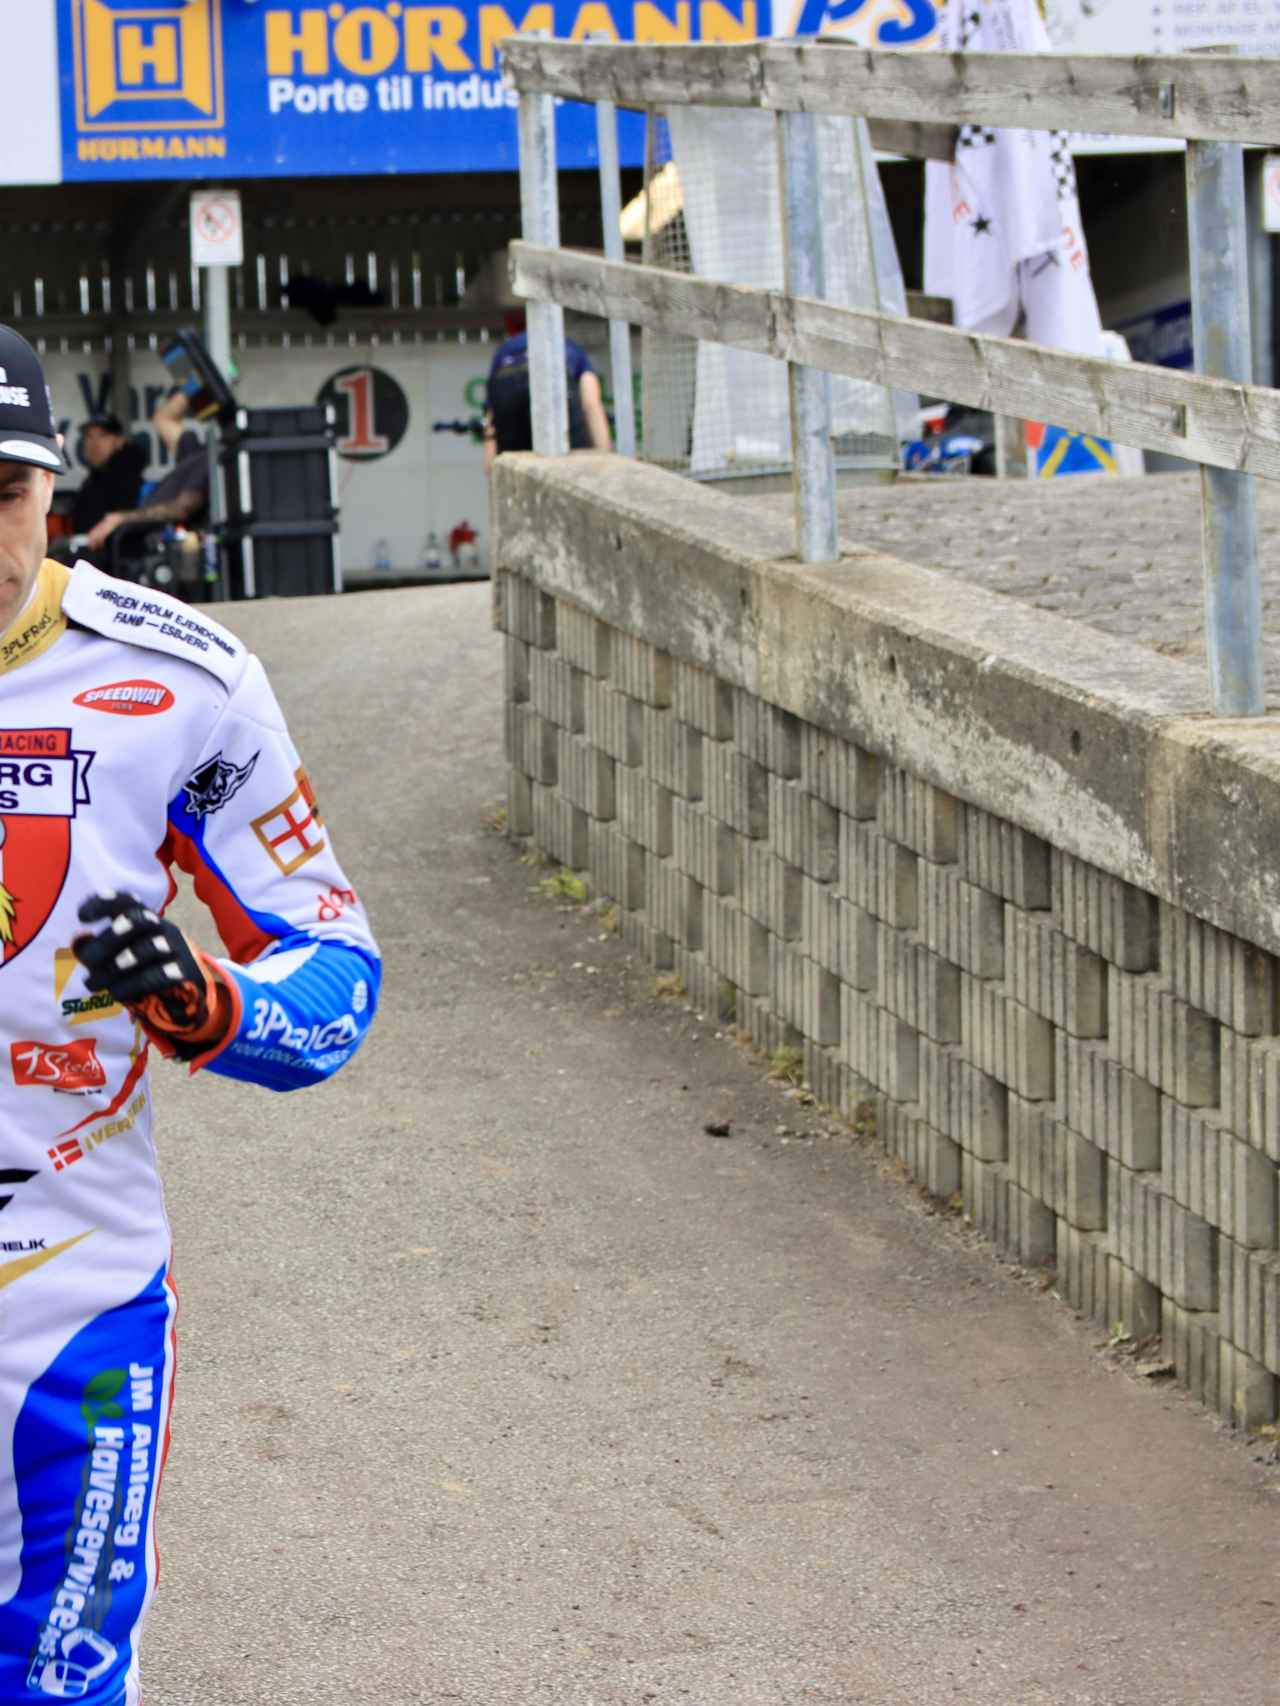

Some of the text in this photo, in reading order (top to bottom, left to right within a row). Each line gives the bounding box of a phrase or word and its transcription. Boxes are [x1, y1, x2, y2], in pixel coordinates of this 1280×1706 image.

[270, 78, 369, 113] Porte
[377, 75, 413, 111] til
[335, 370, 388, 453] 1
[96, 588, 139, 611] JØRGEN
[141, 602, 174, 621] HOLM
[113, 610, 146, 627] FANØ
[159, 624, 210, 651] ESBJERG
[83, 686, 167, 706] SPEEDWAY
[108, 1362, 154, 1582] JM Anlæg &
[48, 1426, 125, 1631] Haveservice
